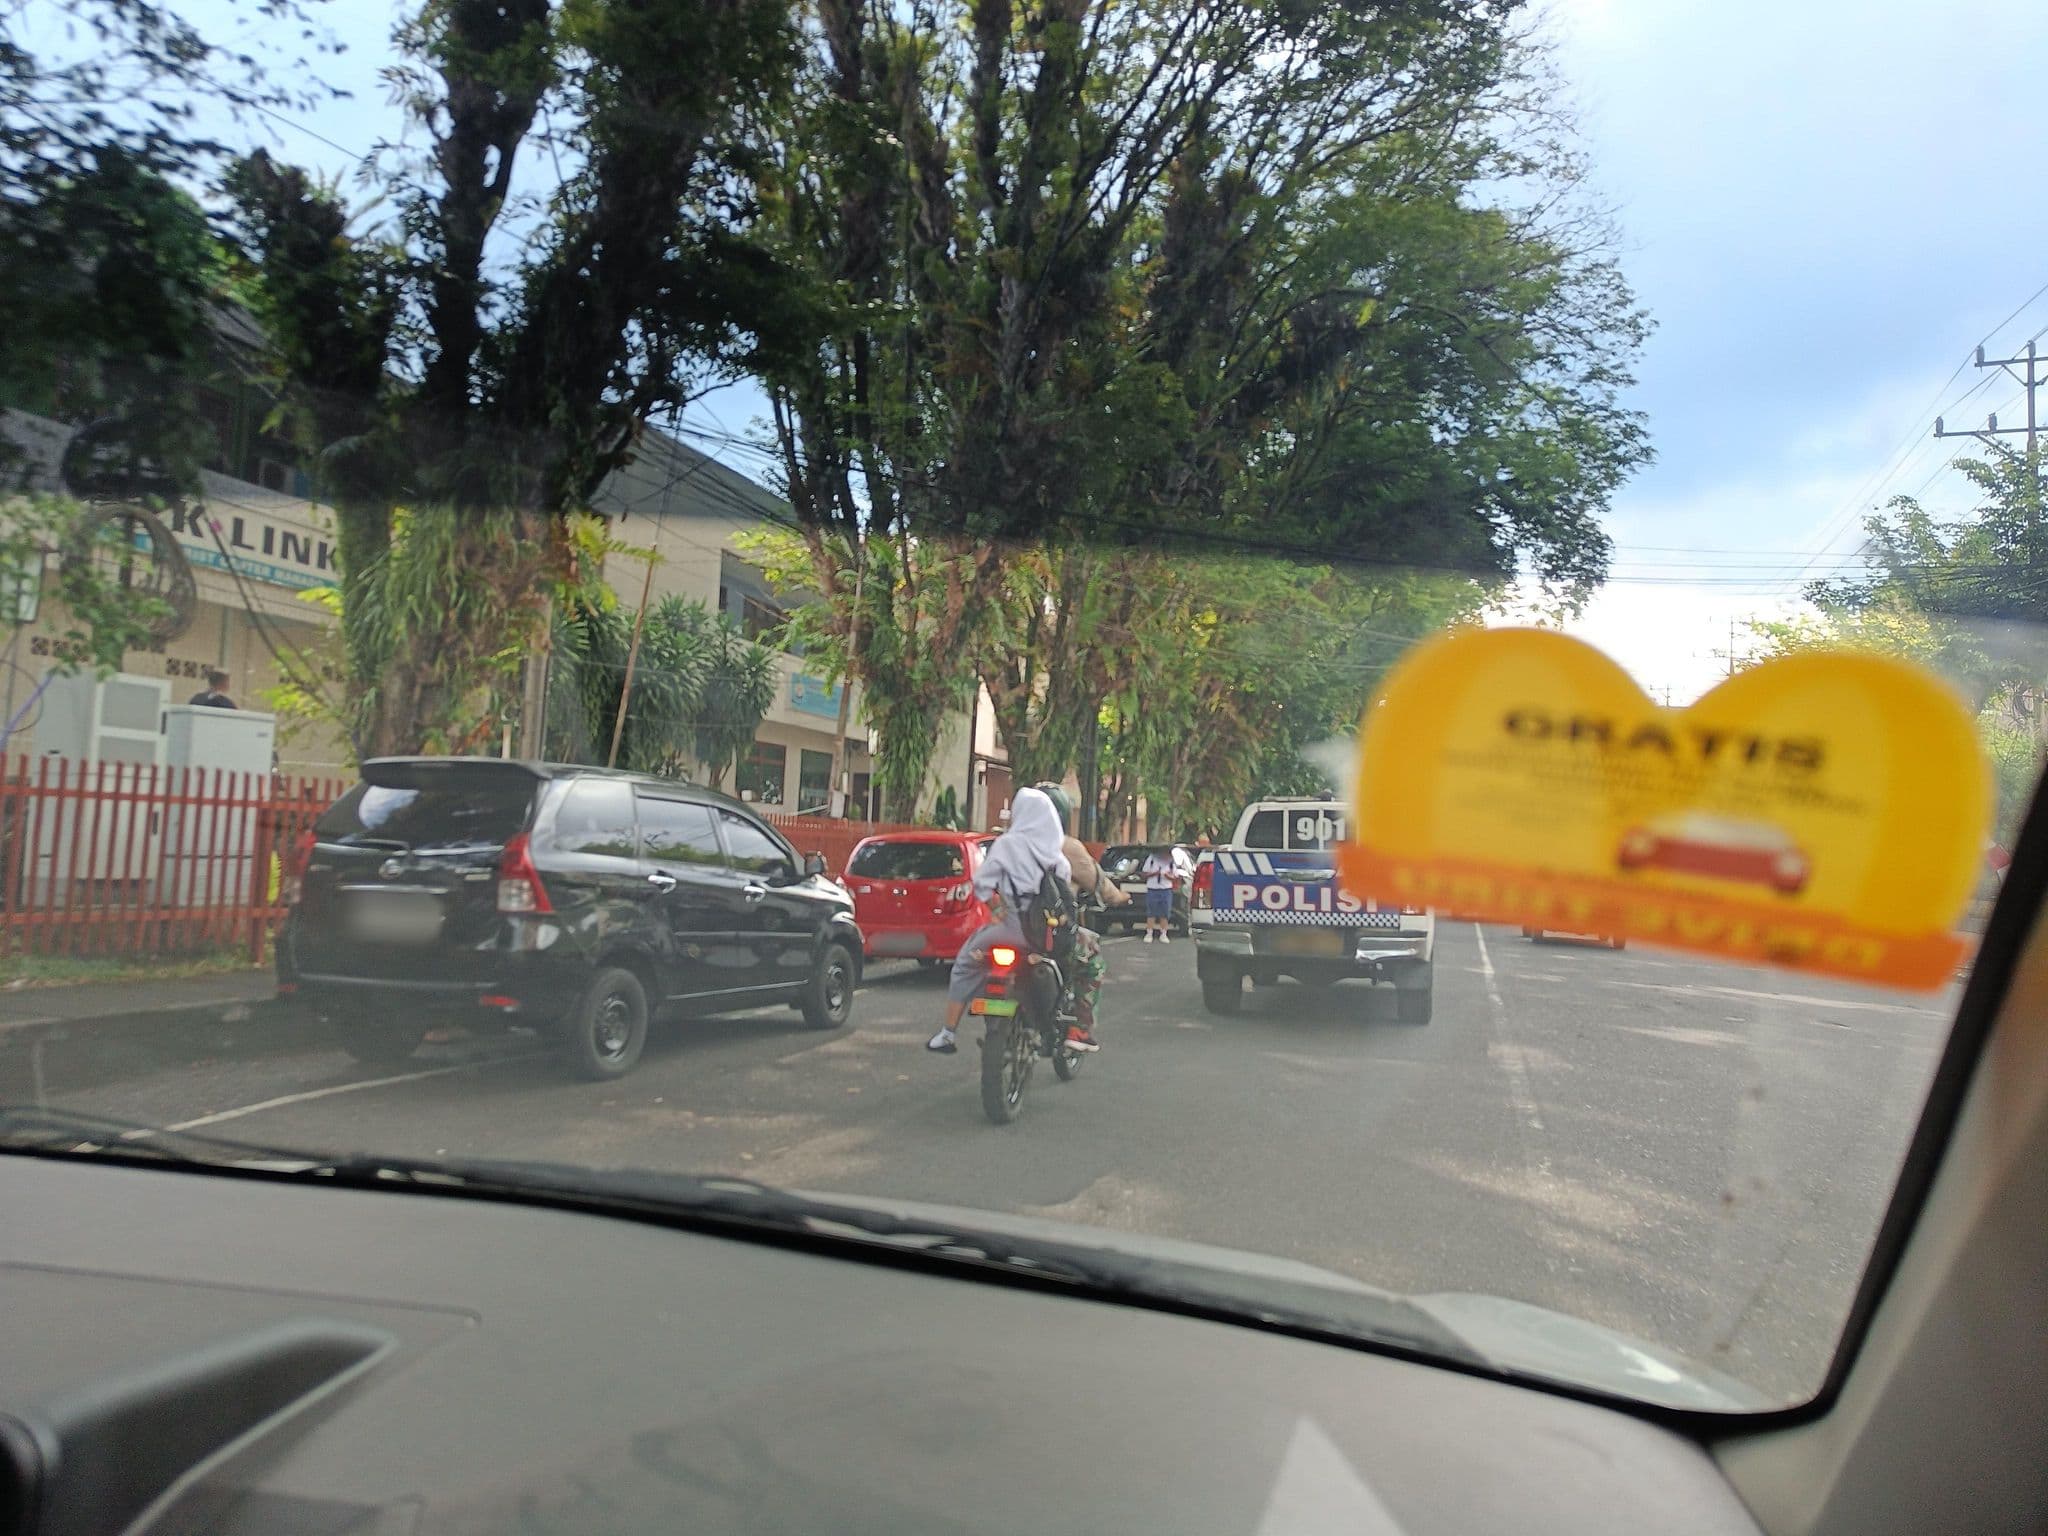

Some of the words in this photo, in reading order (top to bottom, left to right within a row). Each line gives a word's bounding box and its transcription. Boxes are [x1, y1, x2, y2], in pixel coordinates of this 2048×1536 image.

[173, 500, 206, 538] K
[232, 516, 336, 570] LINK
[1502, 708, 1825, 770] GRATIS
[1296, 816, 1346, 841] 901
[1232, 883, 1378, 913] POLISI
